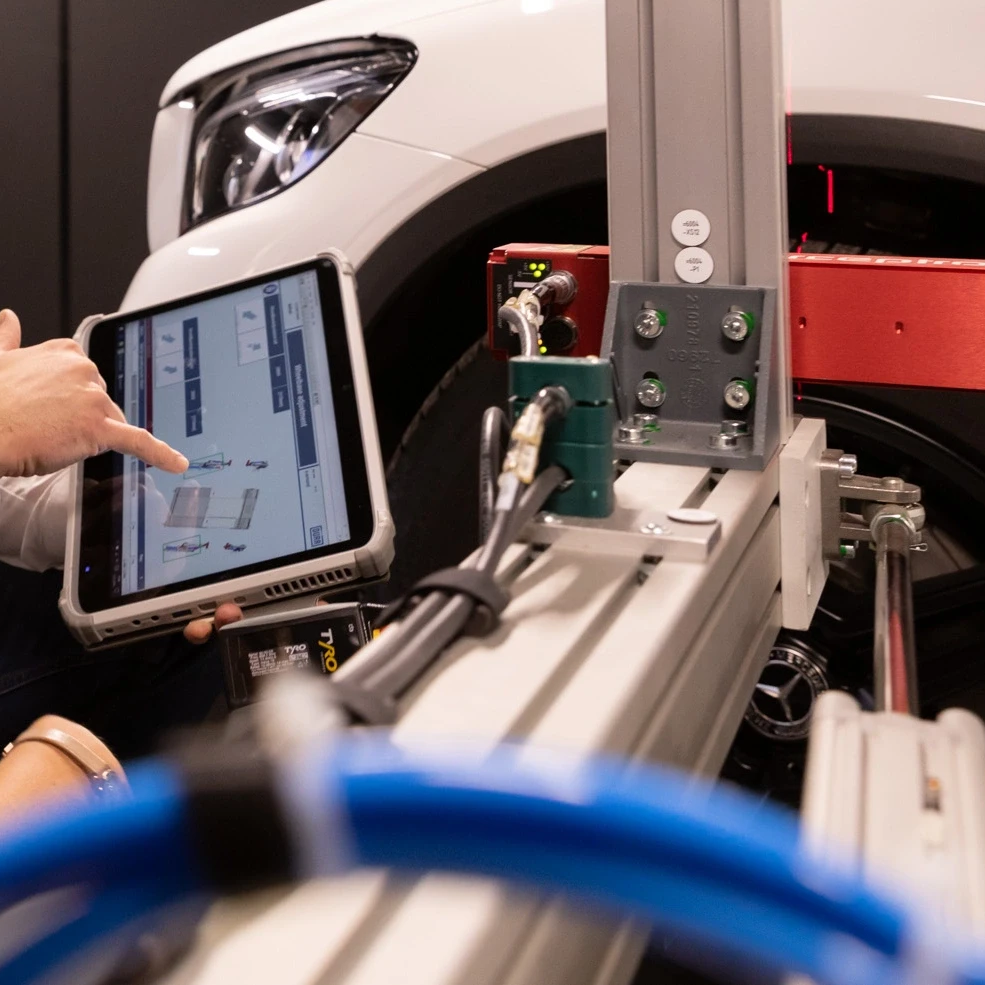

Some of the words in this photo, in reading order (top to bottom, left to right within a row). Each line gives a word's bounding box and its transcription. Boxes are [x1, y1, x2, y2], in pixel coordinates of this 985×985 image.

[296, 395, 308, 427] adjustment
[284, 644, 307, 654] TYRO
[318, 628, 337, 672] TYRO
